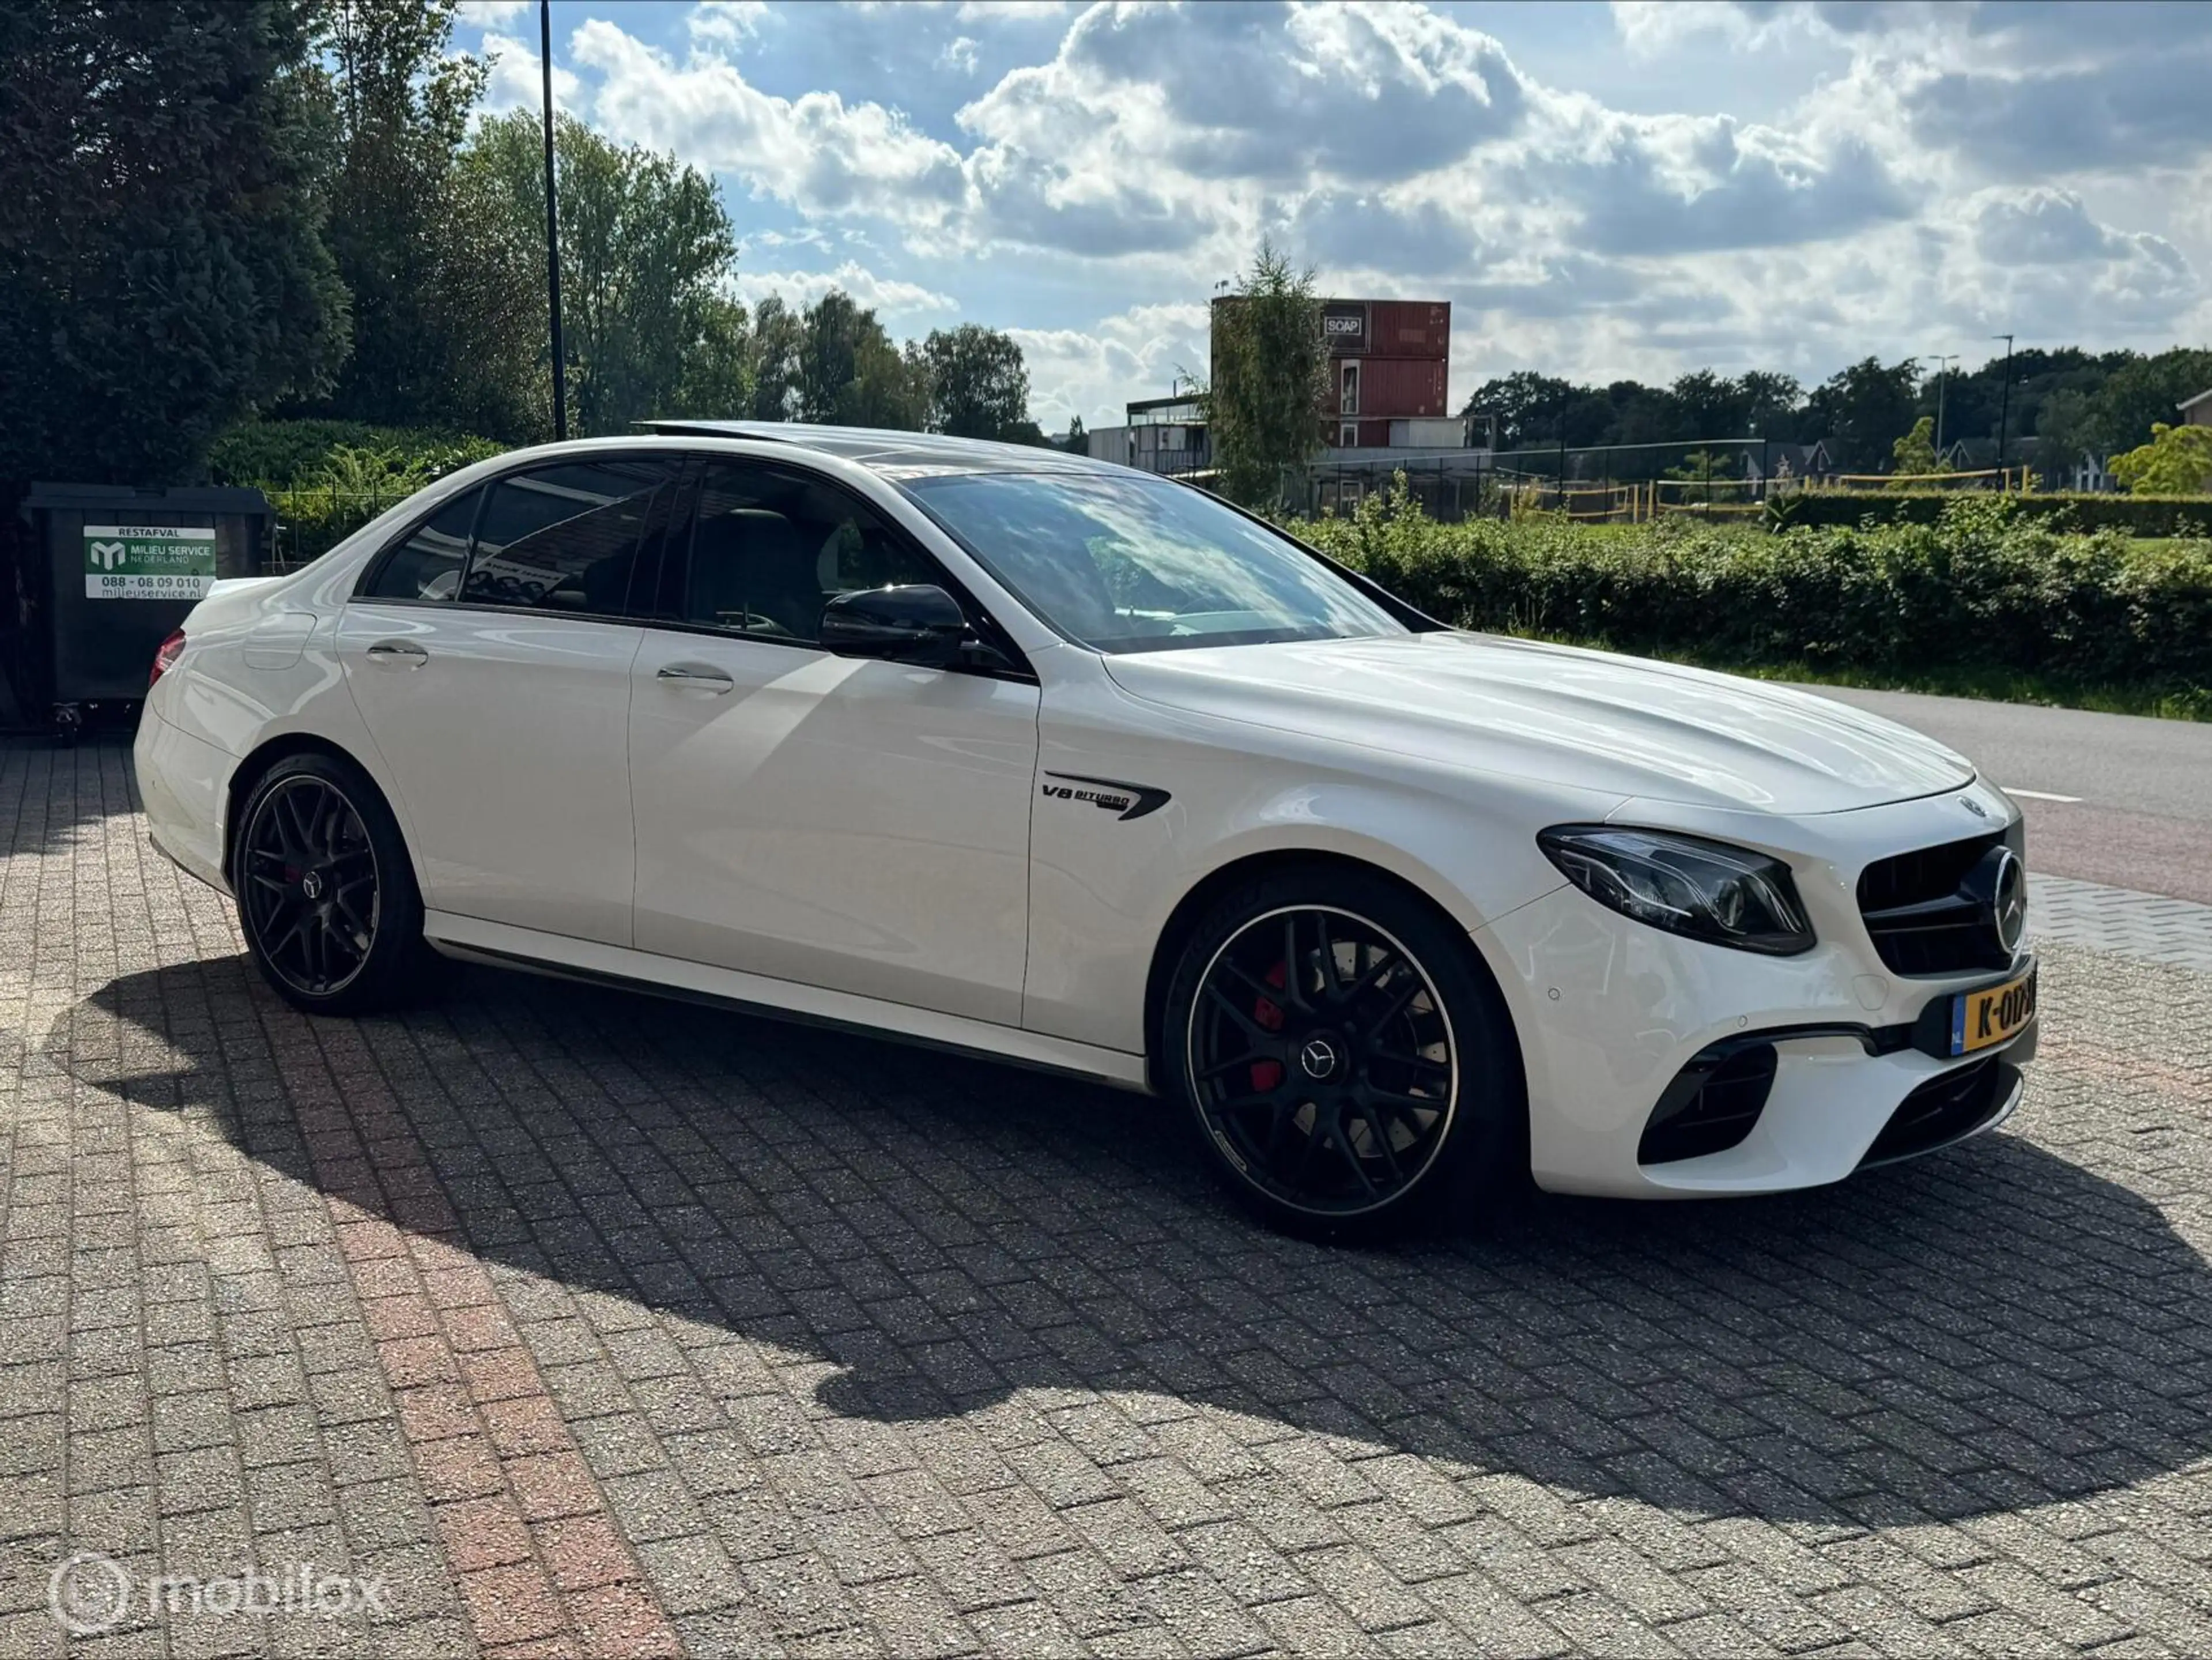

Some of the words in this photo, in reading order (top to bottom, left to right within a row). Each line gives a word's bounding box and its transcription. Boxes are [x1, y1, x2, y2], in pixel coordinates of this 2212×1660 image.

[1328, 320, 1358, 332] SOAP
[118, 528, 179, 537] RESTAFVAL
[130, 545, 165, 555] MILIEU
[168, 545, 210, 556] SERVICE
[130, 555, 189, 564] NEDERLAND
[102, 577, 126, 587] 088
[138, 578, 154, 587] 08
[157, 578, 172, 587] 09
[176, 578, 201, 588] 010
[102, 587, 201, 598] milieuservice.nl
[1042, 784, 1073, 799] V8
[1074, 790, 1130, 805] BITURBO
